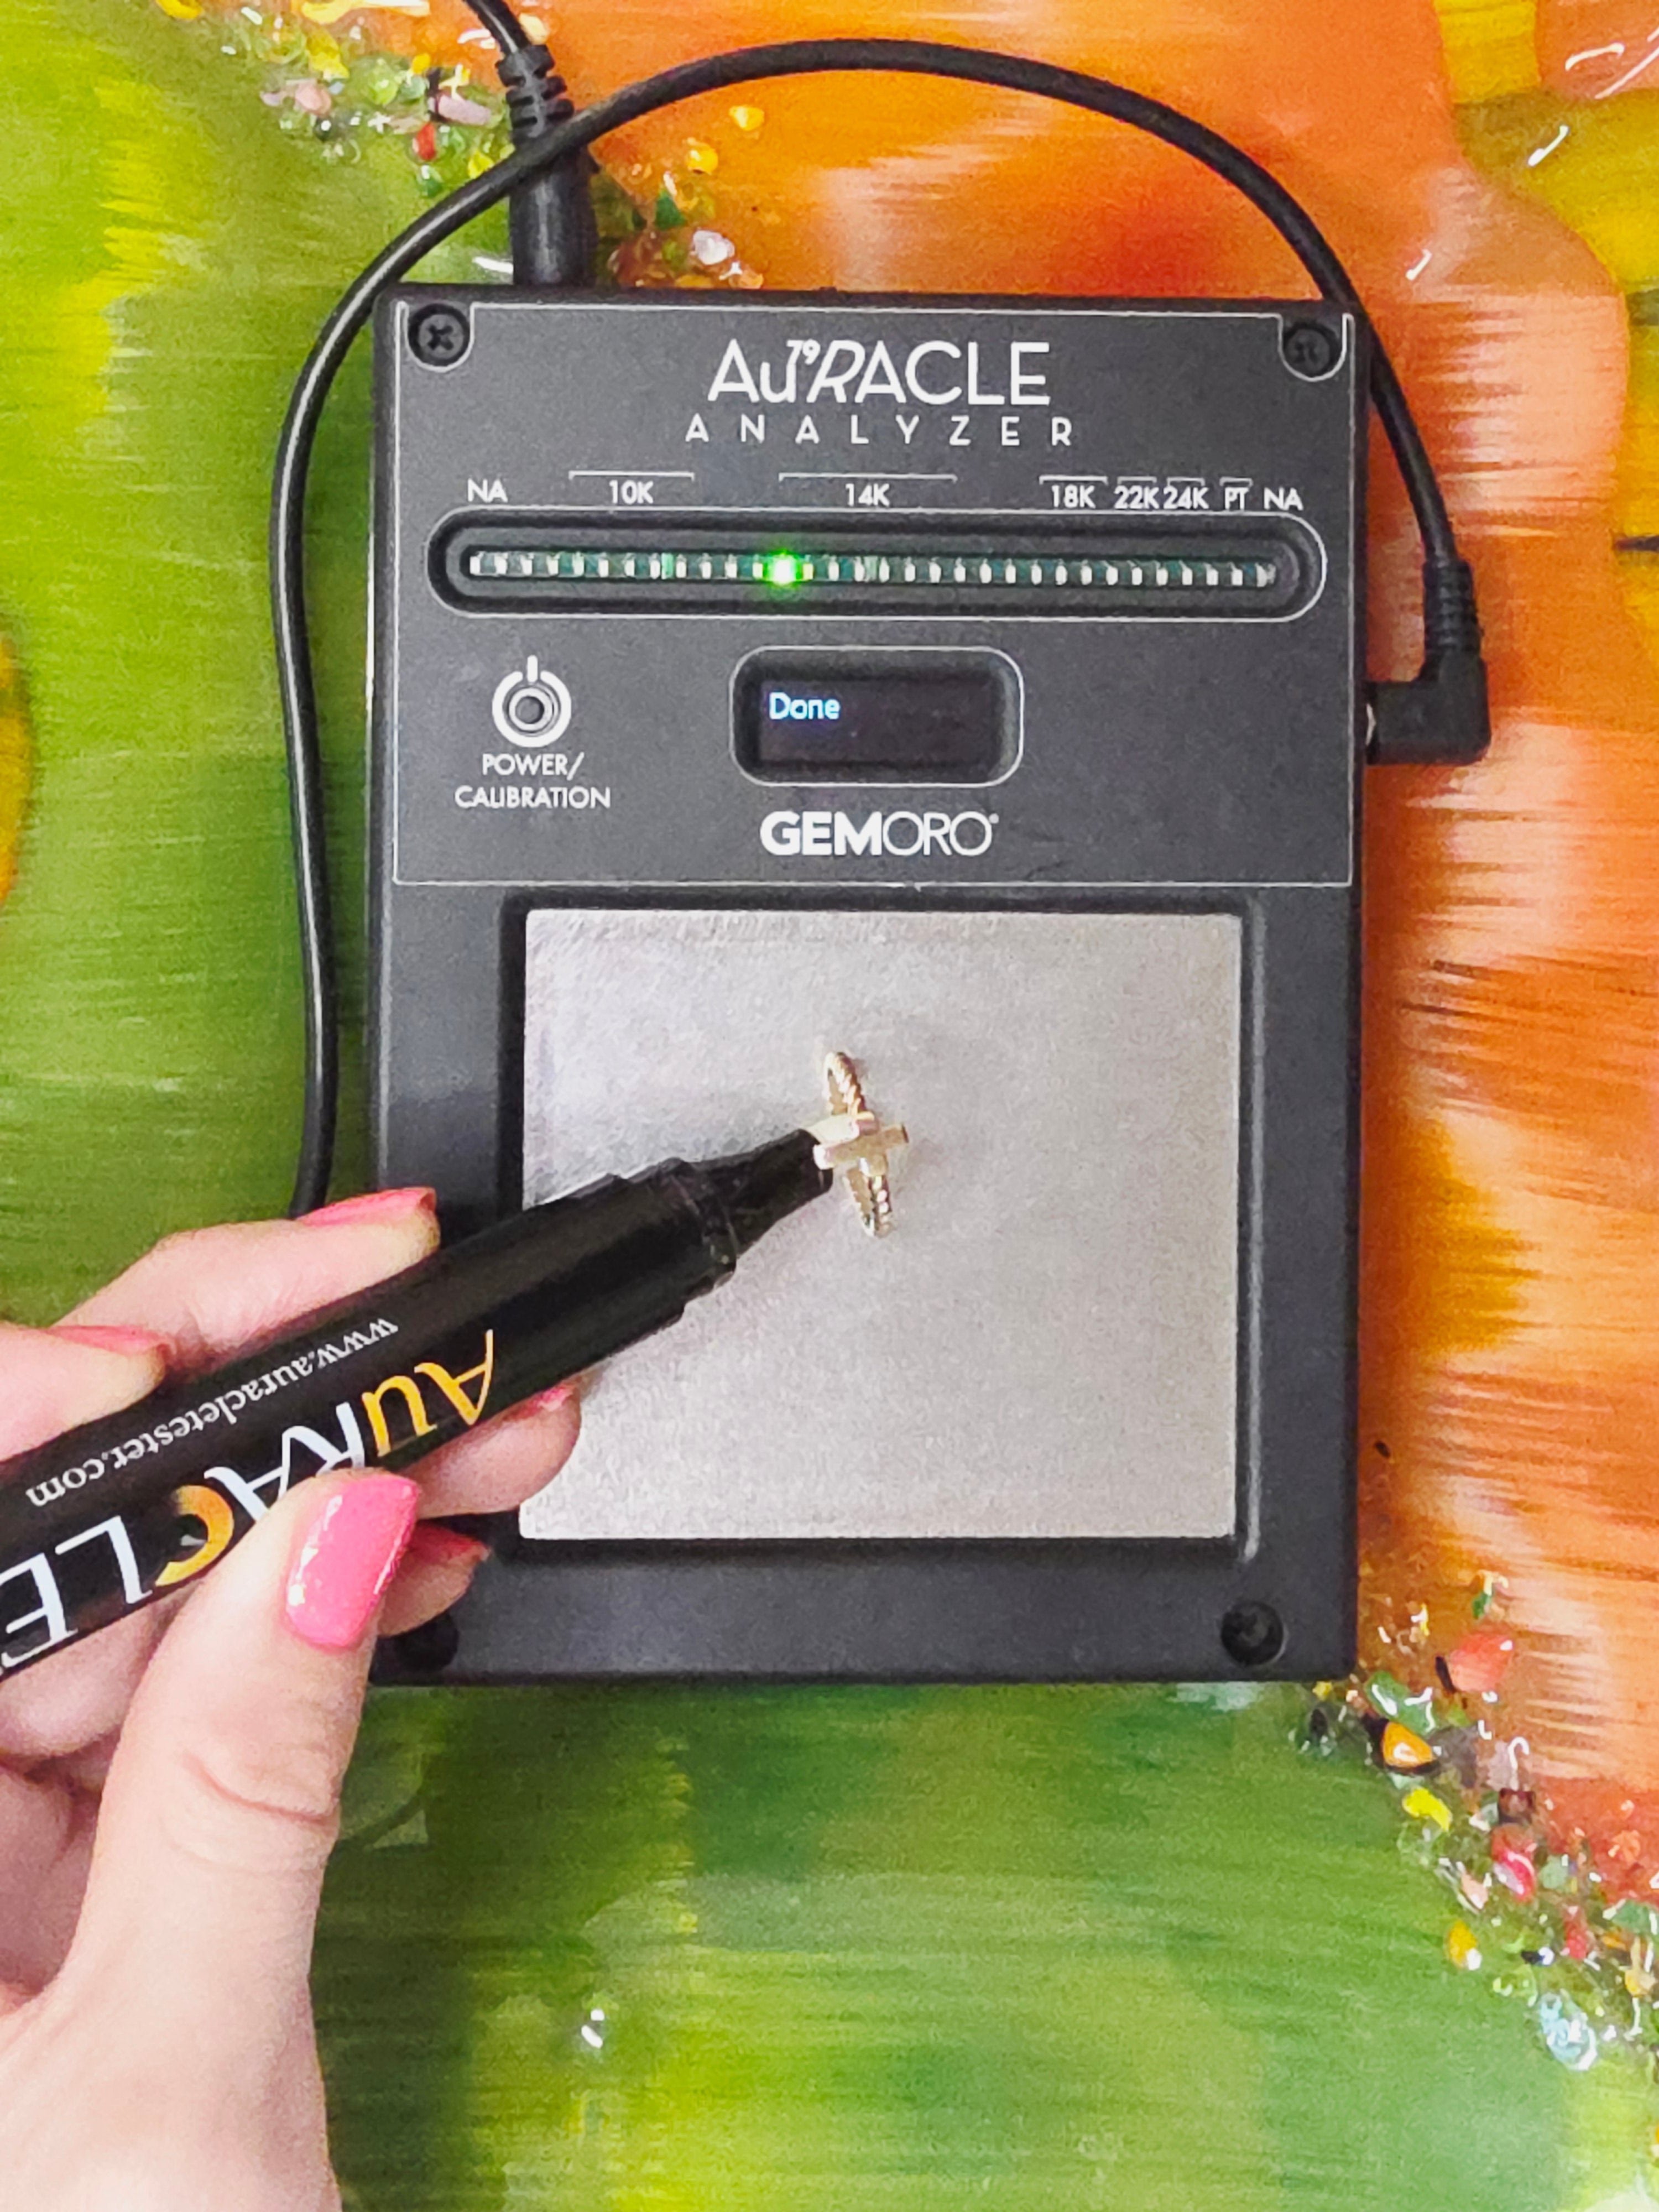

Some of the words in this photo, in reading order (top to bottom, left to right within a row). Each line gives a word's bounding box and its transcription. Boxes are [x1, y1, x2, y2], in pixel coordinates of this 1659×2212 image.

[685, 413, 1072, 446] ANALYZER
[468, 478, 508, 503] NA
[609, 480, 654, 504] 10K
[846, 483, 890, 506] 14K
[1052, 484, 1095, 508] 18K
[1114, 486, 1159, 509] 22K
[1164, 486, 1209, 509] 24K
[1224, 487, 1248, 509] PT
[1264, 488, 1303, 510] NA
[769, 691, 841, 720] Done
[482, 752, 585, 781] POWER/
[455, 785, 611, 809] CALIBRATION
[25, 1317, 399, 1508] www.auracletester.com
